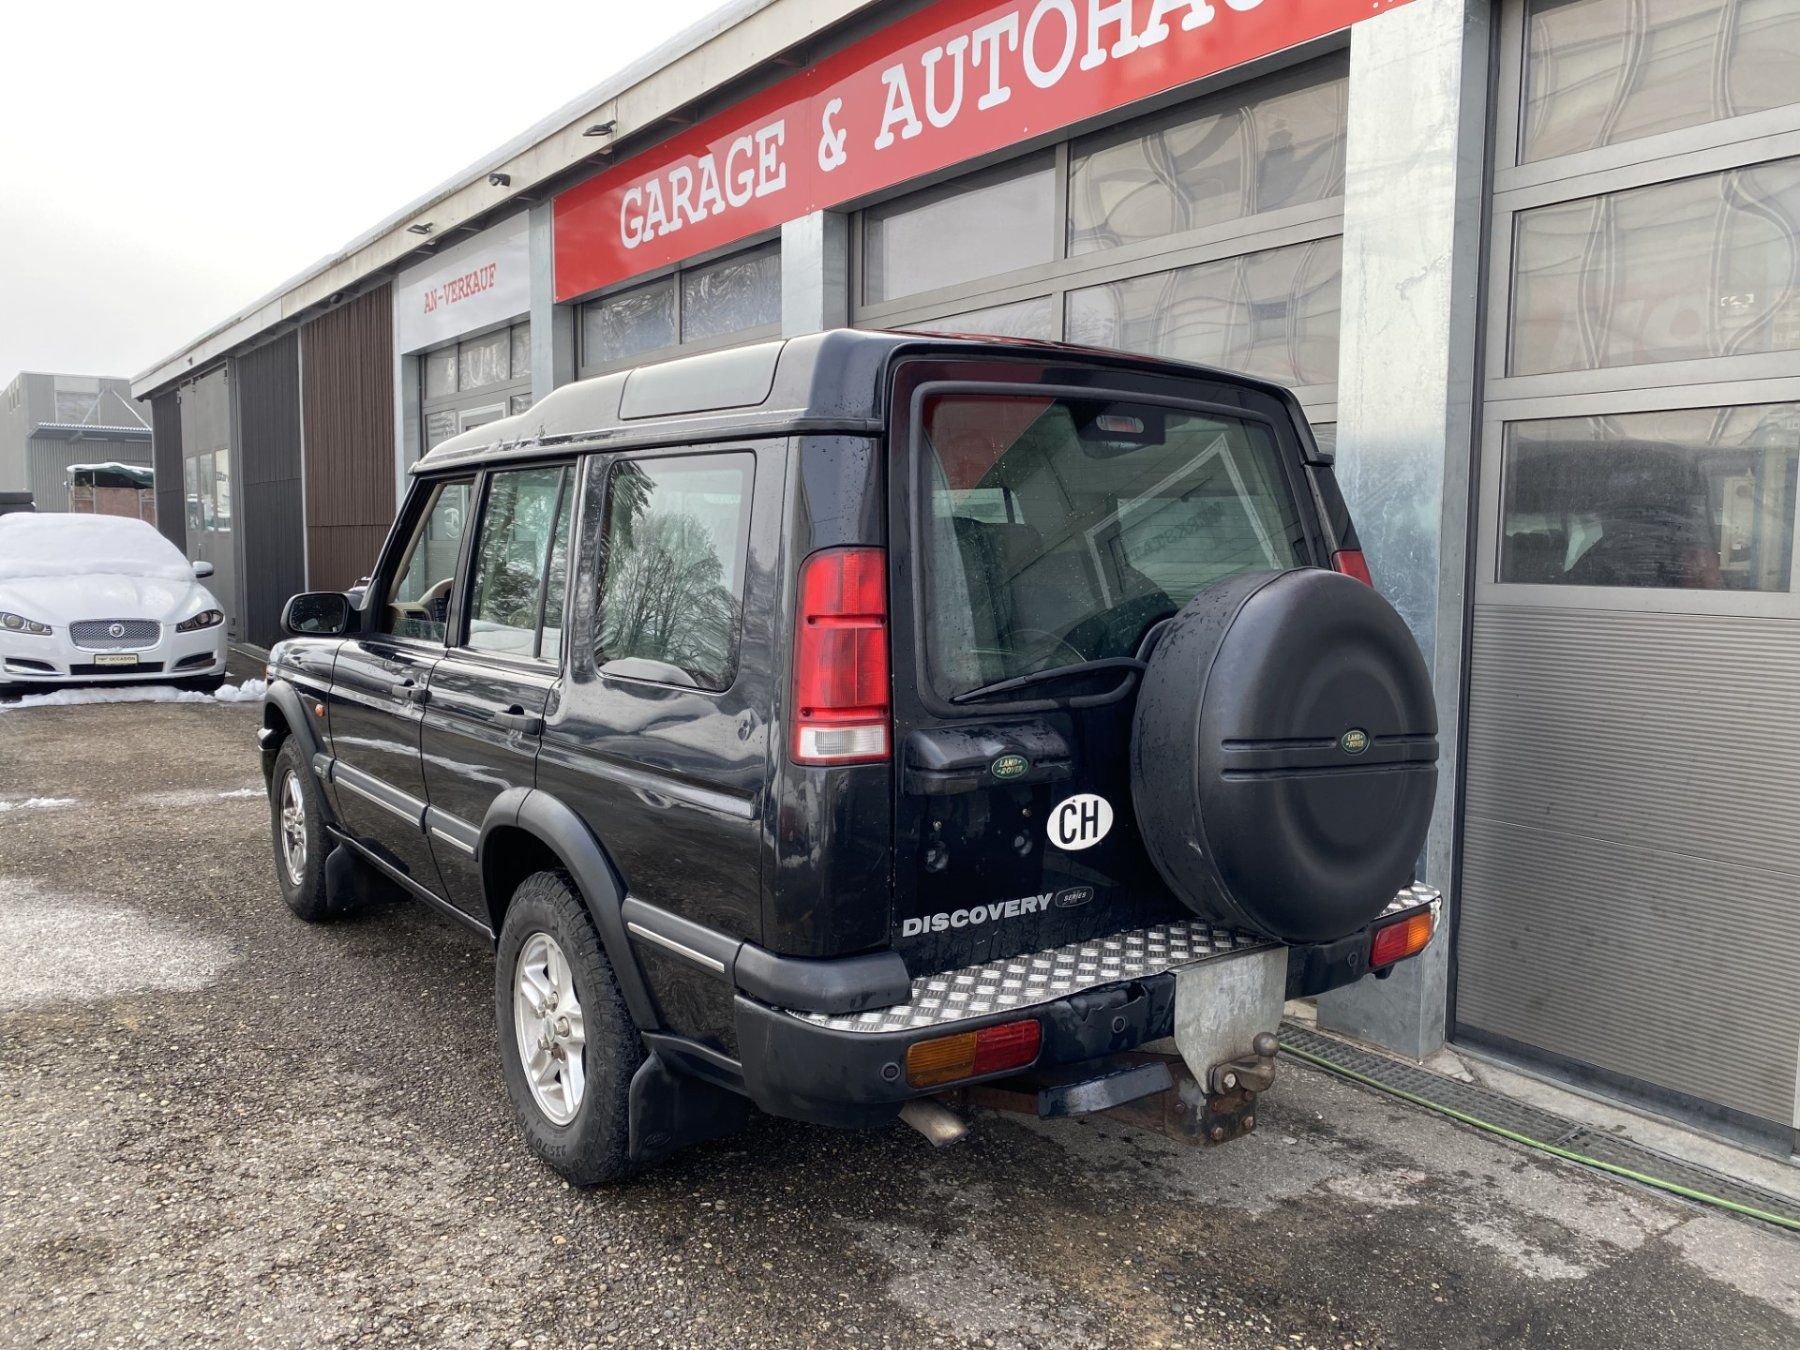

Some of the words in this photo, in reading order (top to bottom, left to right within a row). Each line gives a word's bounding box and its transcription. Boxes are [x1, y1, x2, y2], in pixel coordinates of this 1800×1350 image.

[620, 119, 786, 249] GARAGE
[818, 98, 847, 172] &
[874, 0, 1265, 150] AUTOH
[424, 263, 496, 314] AN-VERKAUF
[999, 759, 1018, 767] LAND
[1000, 765, 1023, 774] ROVER
[1059, 800, 1098, 844] CH
[902, 893, 1053, 938] DISCOVERY
